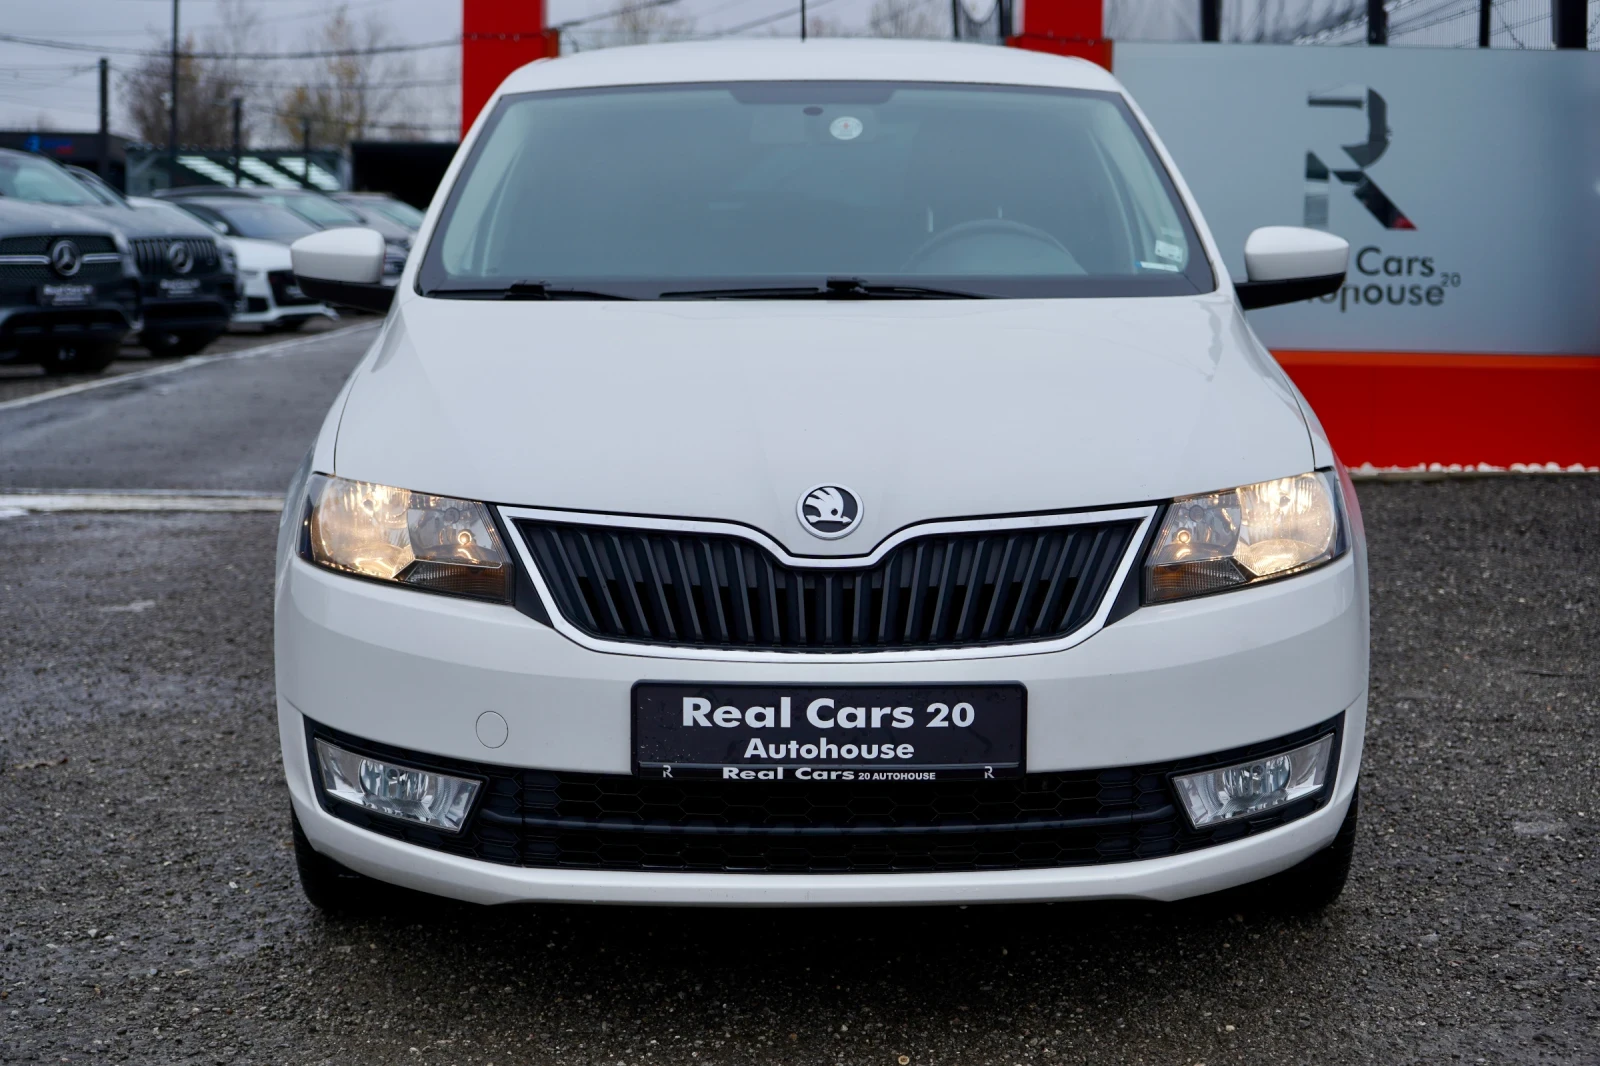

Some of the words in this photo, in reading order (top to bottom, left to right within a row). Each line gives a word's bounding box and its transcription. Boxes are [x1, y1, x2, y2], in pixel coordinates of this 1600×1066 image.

[1355, 245, 1435, 278] Cars
[1440, 272, 1462, 288] 20
[682, 697, 791, 728] Real
[806, 698, 914, 728] Cars
[926, 702, 975, 727] 20
[744, 737, 915, 759] Autohouse
[722, 767, 783, 780] Real
[795, 767, 855, 780] Cars
[858, 772, 871, 780] 20
[872, 772, 936, 780] AUTOHOUSE
